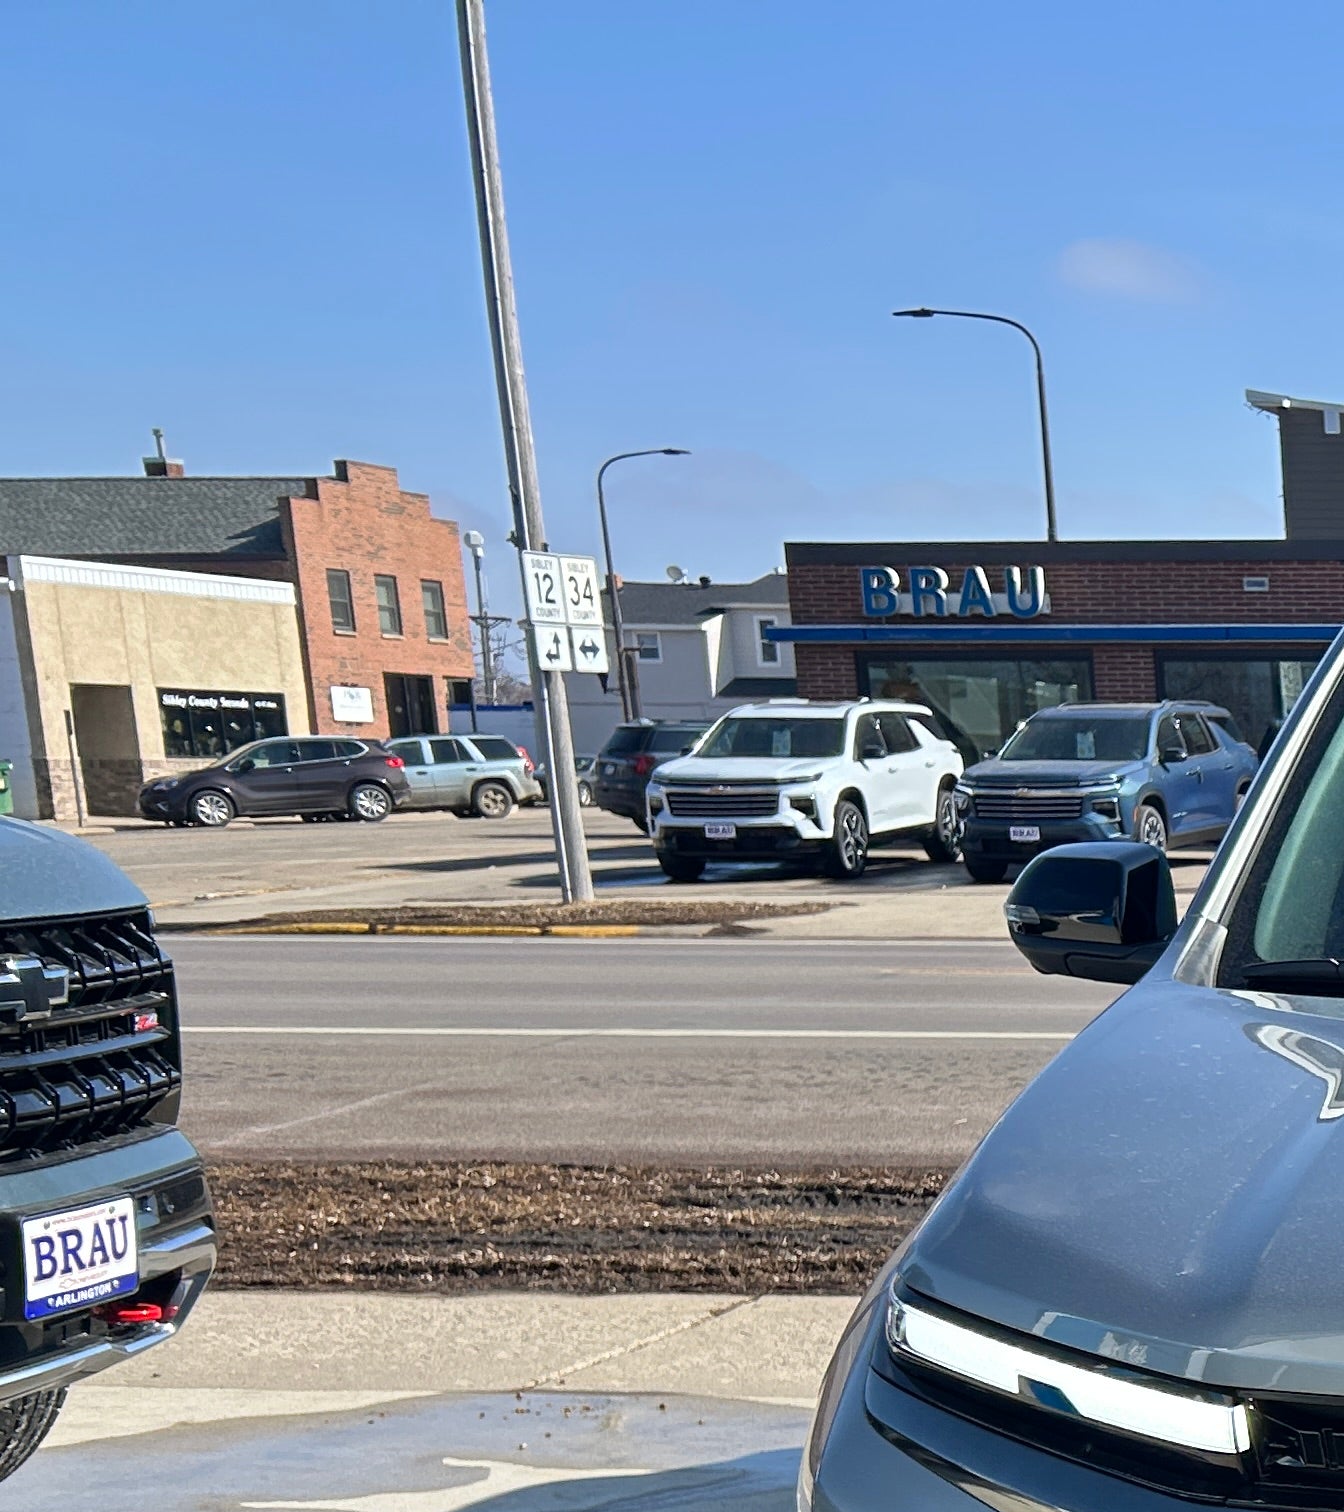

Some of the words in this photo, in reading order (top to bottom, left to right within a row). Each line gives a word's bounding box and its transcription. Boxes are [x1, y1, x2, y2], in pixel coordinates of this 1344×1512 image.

[531, 558, 553, 570] SIBLEY
[567, 562, 589, 573] SIBLEY
[534, 572, 556, 604] 12
[569, 575, 594, 608] 34
[860, 564, 1046, 619] BRAU
[536, 607, 560, 618] COUNTY
[573, 609, 597, 620] COUNTY
[188, 695, 218, 710] County
[31, 1215, 128, 1282] BRAU
[55, 1282, 112, 1307] ARLINGTON
